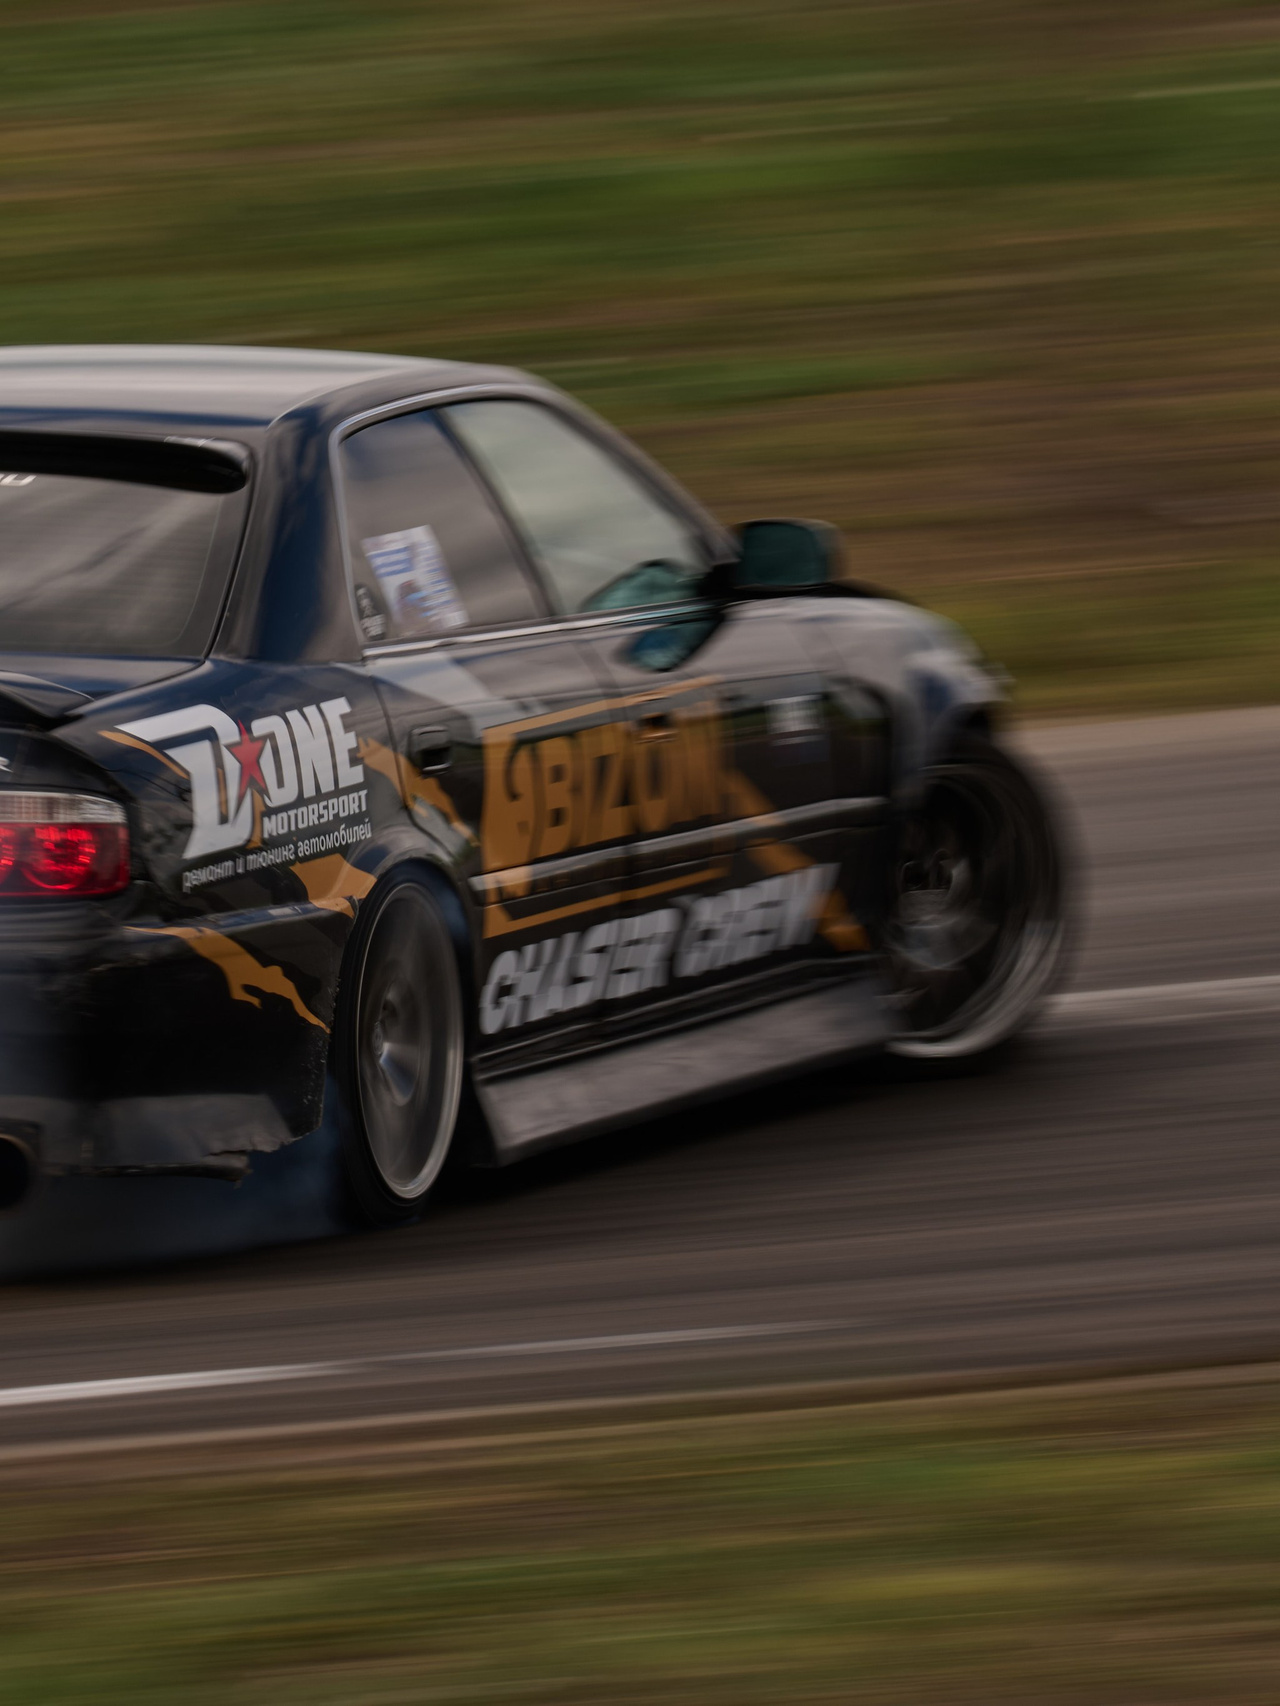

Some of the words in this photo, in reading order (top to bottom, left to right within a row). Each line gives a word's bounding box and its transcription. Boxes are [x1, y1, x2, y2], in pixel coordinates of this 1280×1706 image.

[262, 790, 368, 839] MOTORSPORT
[182, 859, 234, 893] ремонт
[235, 856, 245, 874] и
[246, 844, 295, 871] тюнинг
[297, 818, 372, 856] автомобилей
[480, 907, 682, 1035] CHASER
